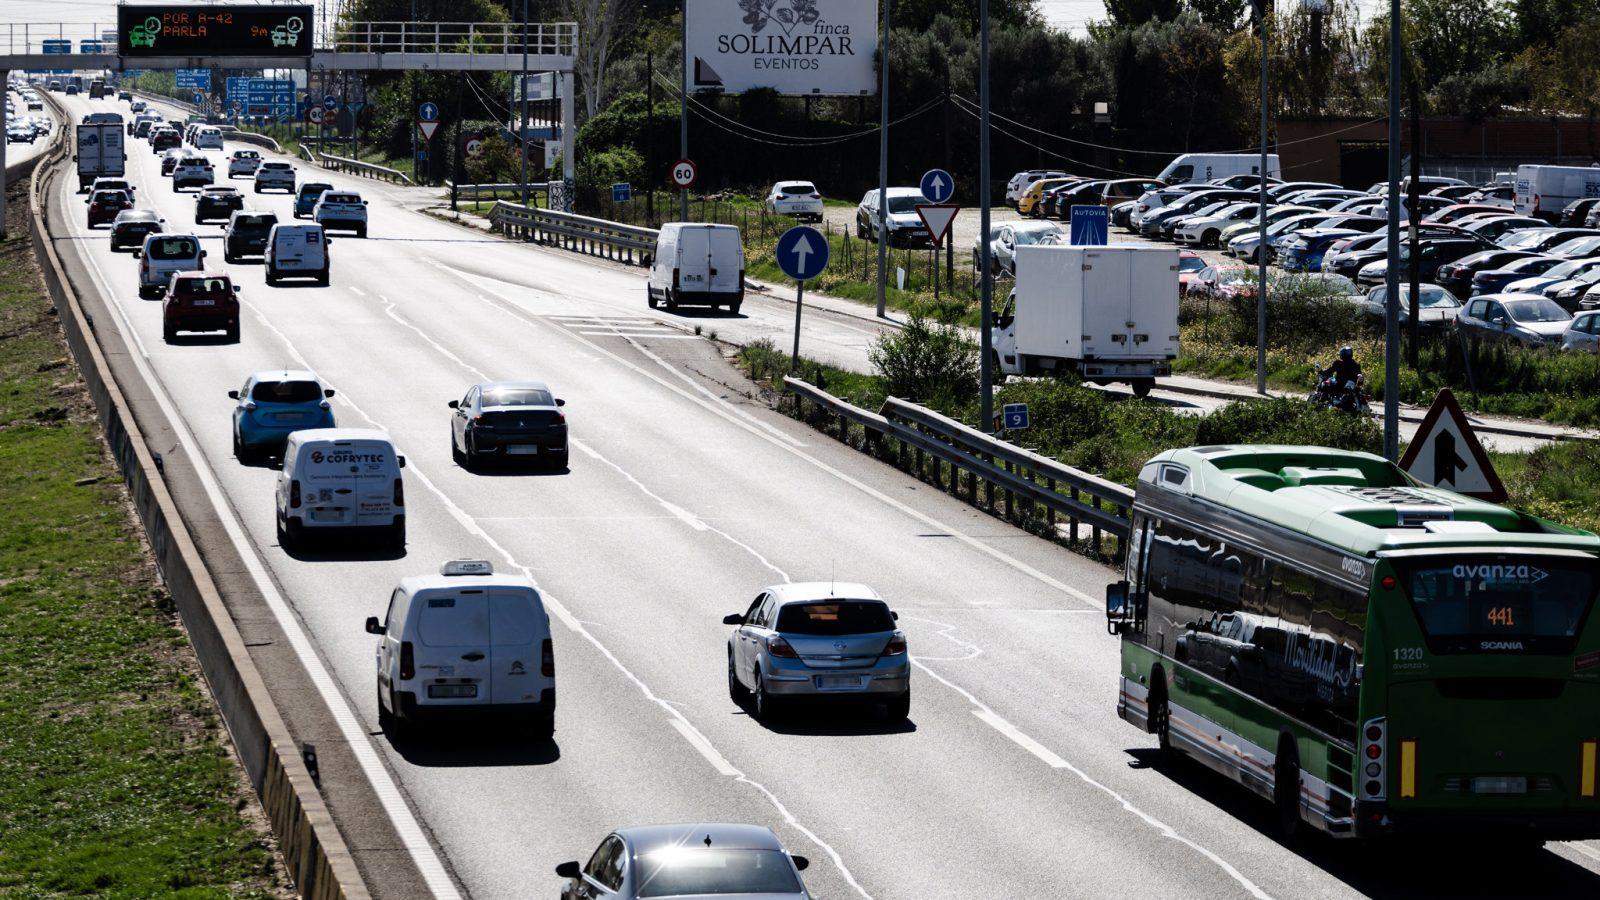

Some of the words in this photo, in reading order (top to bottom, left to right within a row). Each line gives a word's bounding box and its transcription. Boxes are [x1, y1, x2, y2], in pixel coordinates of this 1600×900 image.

[163, 13, 189, 24] POR
[198, 13, 233, 24] A-42
[163, 26, 207, 37] PARLA
[250, 26, 268, 37] 9m
[813, 19, 850, 35] finca
[718, 34, 855, 56] SOLIMPAR
[754, 58, 819, 70] EVENTOS
[675, 169, 692, 179] 60
[1013, 415, 1021, 425] 9
[327, 454, 384, 464] COFRYTEC
[1452, 564, 1529, 578] avanza
[1487, 607, 1514, 626] 441
[1480, 641, 1524, 650] SCANIA
[1393, 647, 1423, 660] 1320
